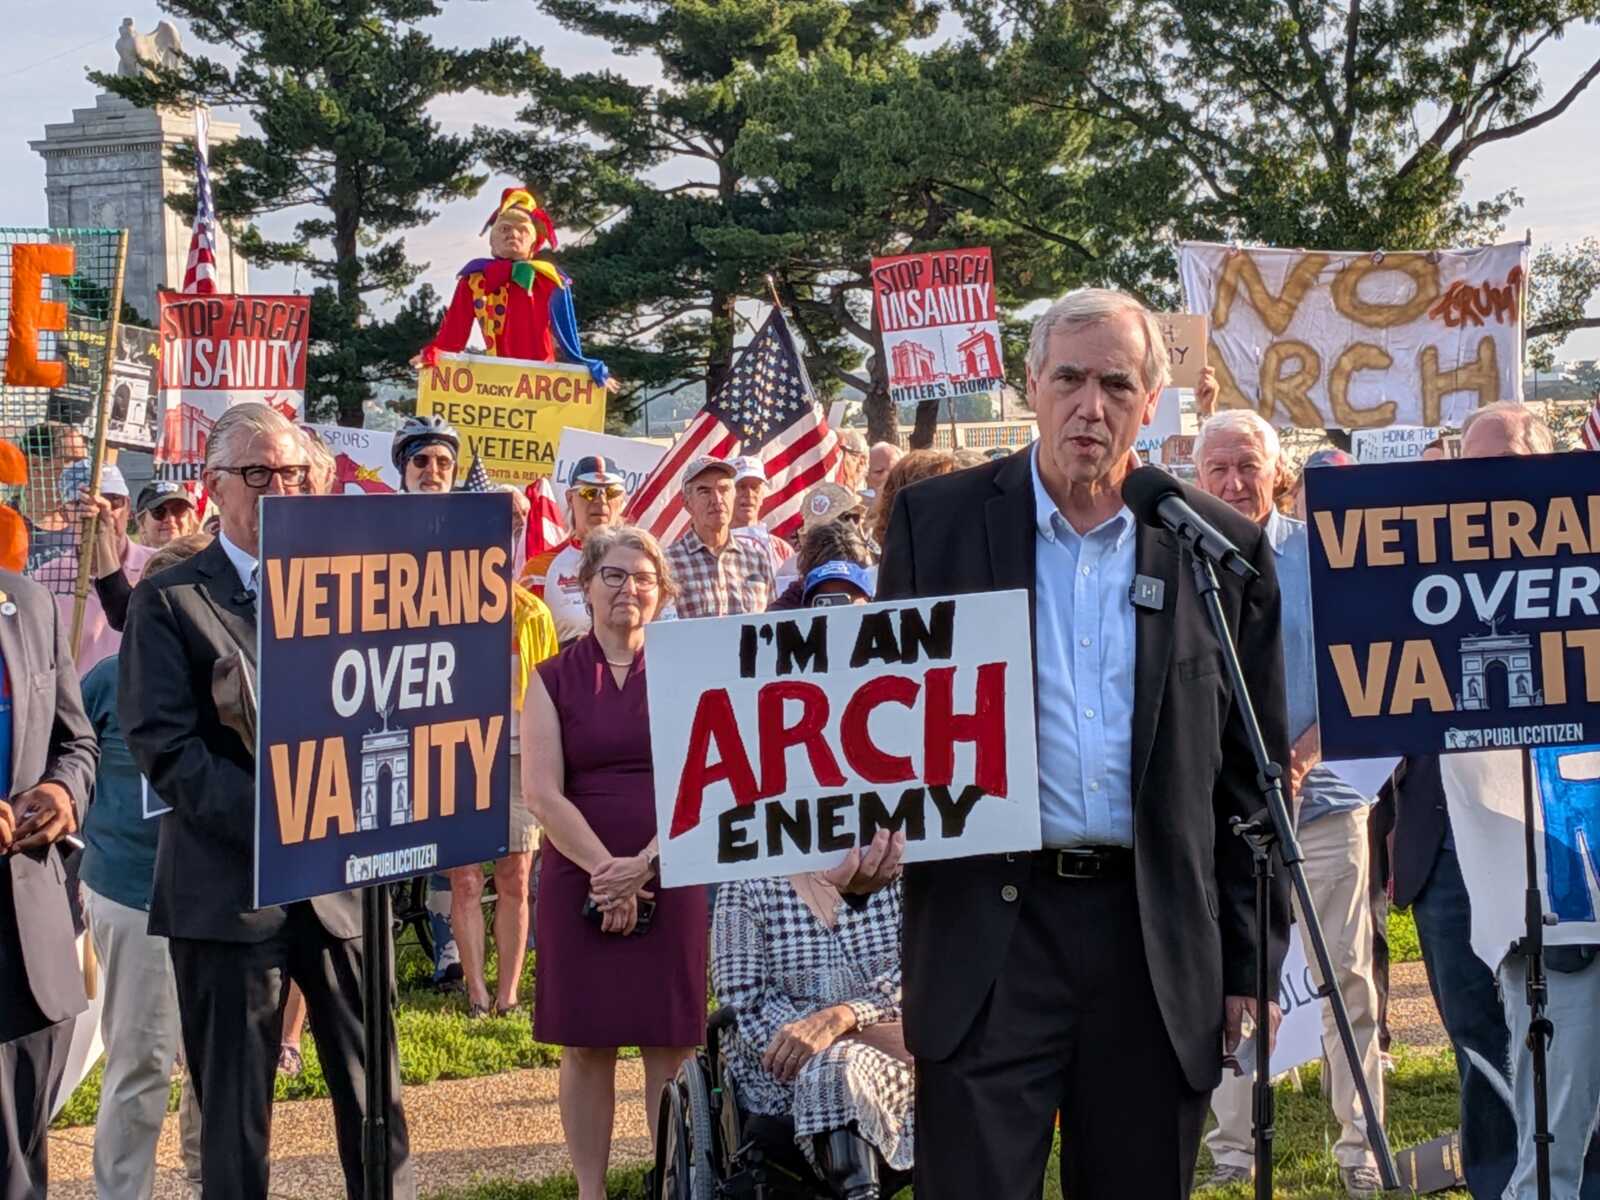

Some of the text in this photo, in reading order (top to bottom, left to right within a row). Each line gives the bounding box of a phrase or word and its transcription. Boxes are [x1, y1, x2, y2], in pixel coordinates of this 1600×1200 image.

[873, 255, 990, 296] STOP ARCH
[1211, 248, 1440, 335] NO
[162, 298, 306, 342] STOP ARCH
[880, 282, 991, 329] INSANITY
[163, 337, 303, 388] INSANITY
[430, 366, 594, 405] NO TACKY ARCH
[1205, 335, 1501, 428] ARCH
[432, 401, 538, 432] RESPECT
[891, 382, 947, 401] HITLER'S
[323, 430, 370, 449] SPURS
[467, 435, 556, 463] VETERA
[1312, 495, 1600, 569] VETERA
[266, 546, 508, 640] VETERANS
[1412, 566, 1600, 626] OVER
[739, 600, 956, 678] I'M AN
[331, 641, 456, 718] OVER
[669, 661, 1008, 840] ARCH
[717, 783, 986, 864] ENEMY
